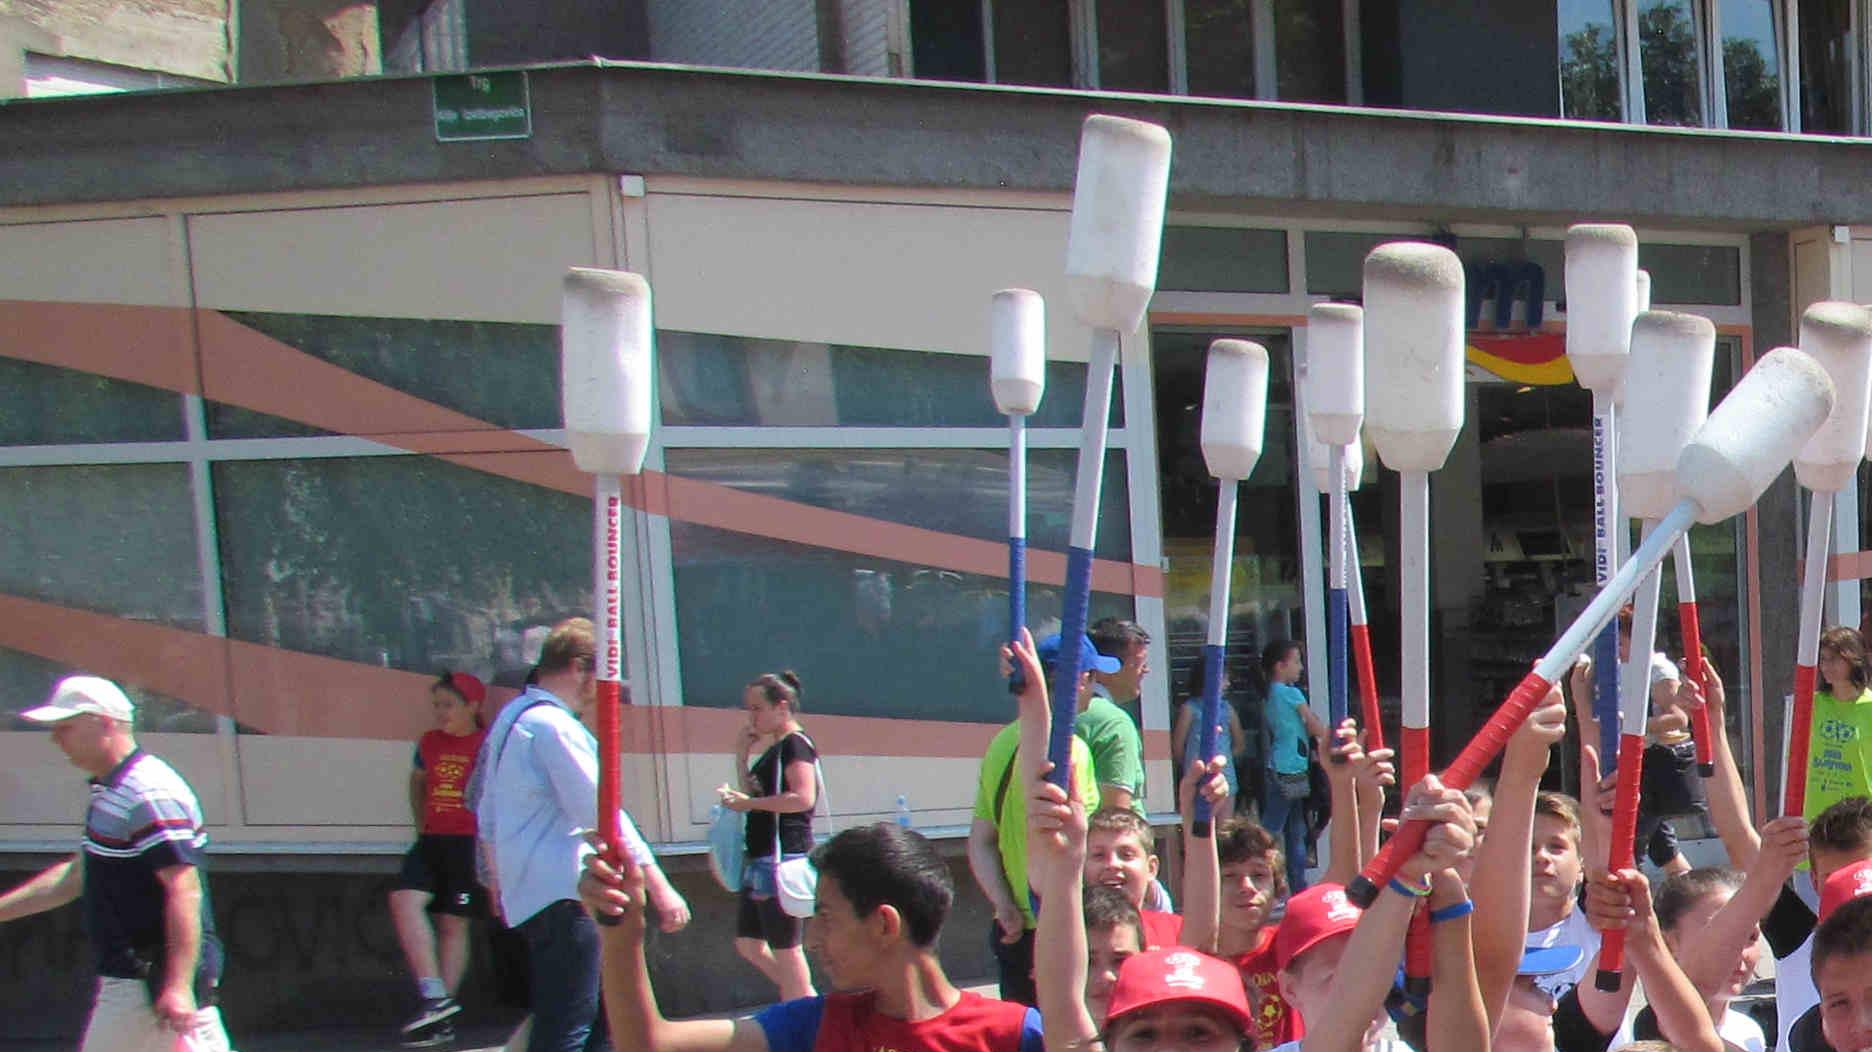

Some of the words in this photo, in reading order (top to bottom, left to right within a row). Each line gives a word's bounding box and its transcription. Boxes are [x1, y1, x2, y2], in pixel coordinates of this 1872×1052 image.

[1594, 417, 1605, 494] BOUNCER
[607, 496, 618, 580] BOUNCER
[1596, 496, 1606, 538] BALL
[607, 587, 618, 628] BALL
